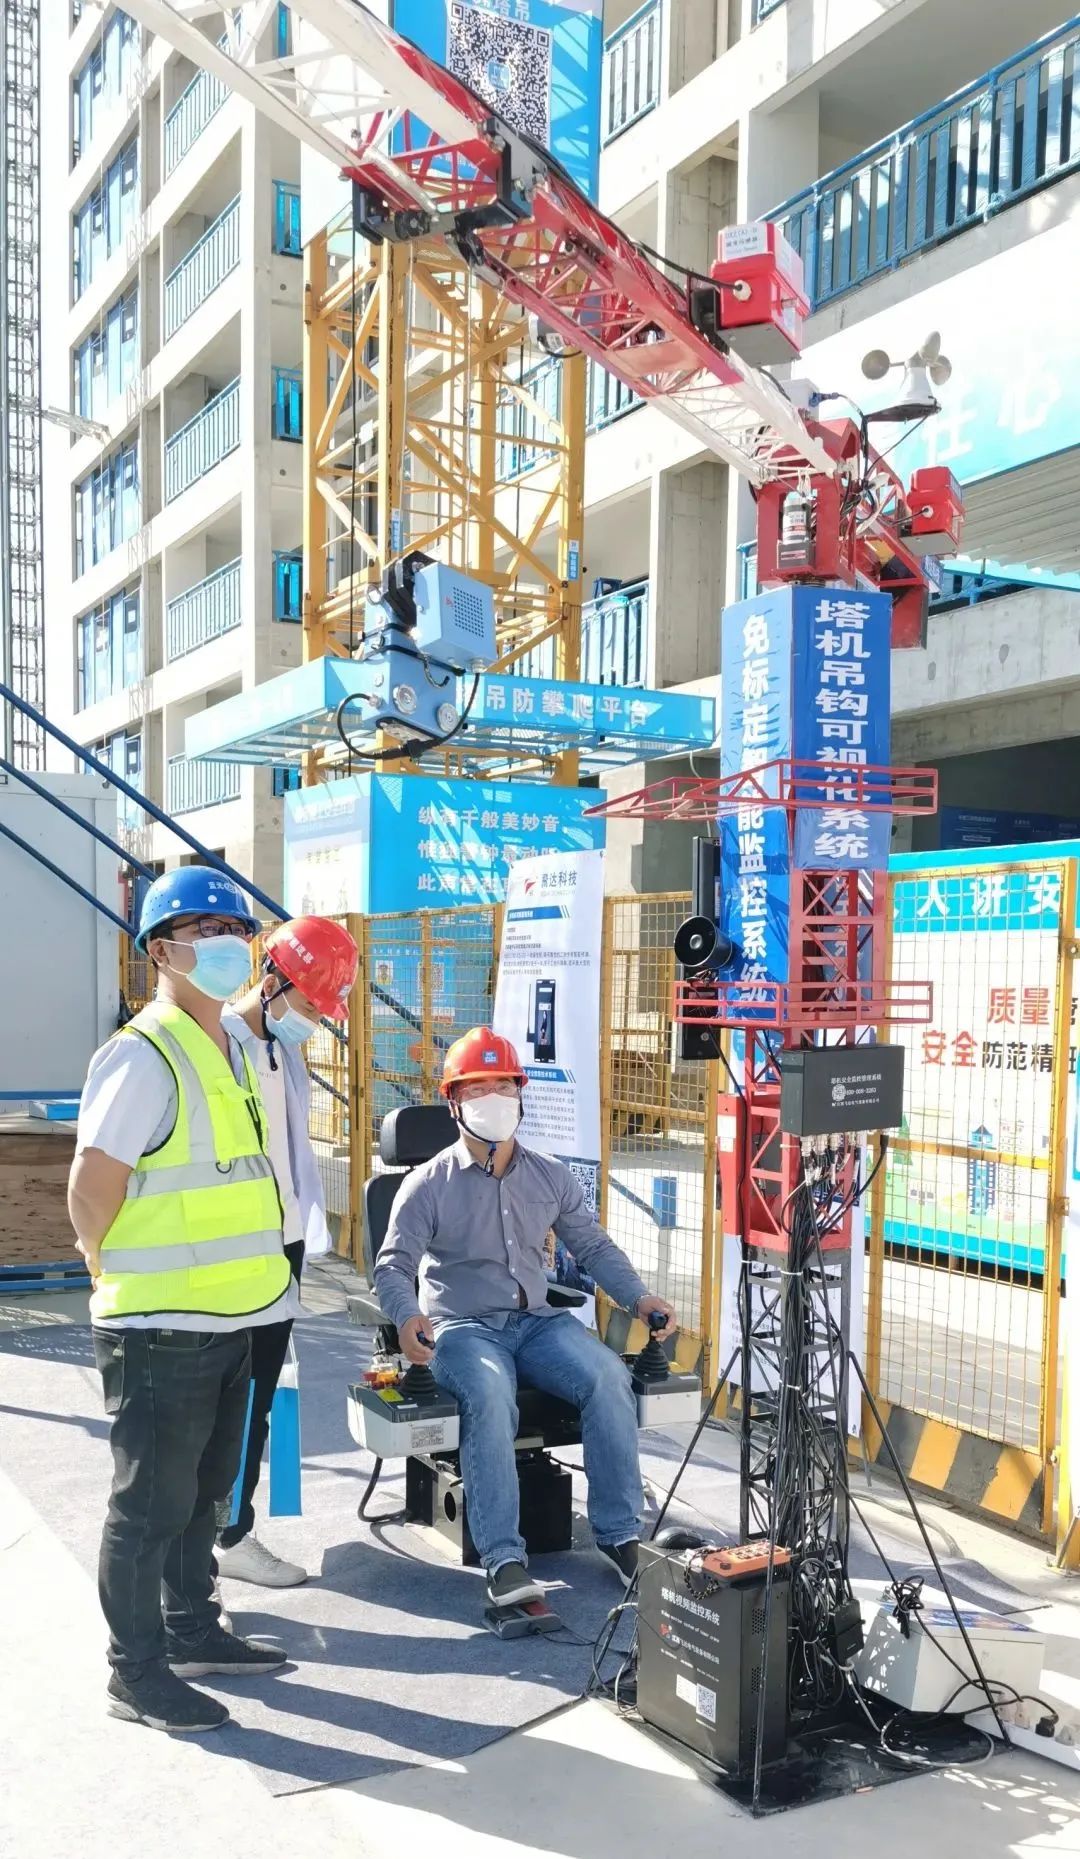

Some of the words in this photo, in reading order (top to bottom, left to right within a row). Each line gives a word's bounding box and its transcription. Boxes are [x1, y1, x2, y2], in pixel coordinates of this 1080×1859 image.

[815, 600, 871, 860] 塔机吊钩可视化系统
[418, 806, 560, 833] 纵有千般美妙音
